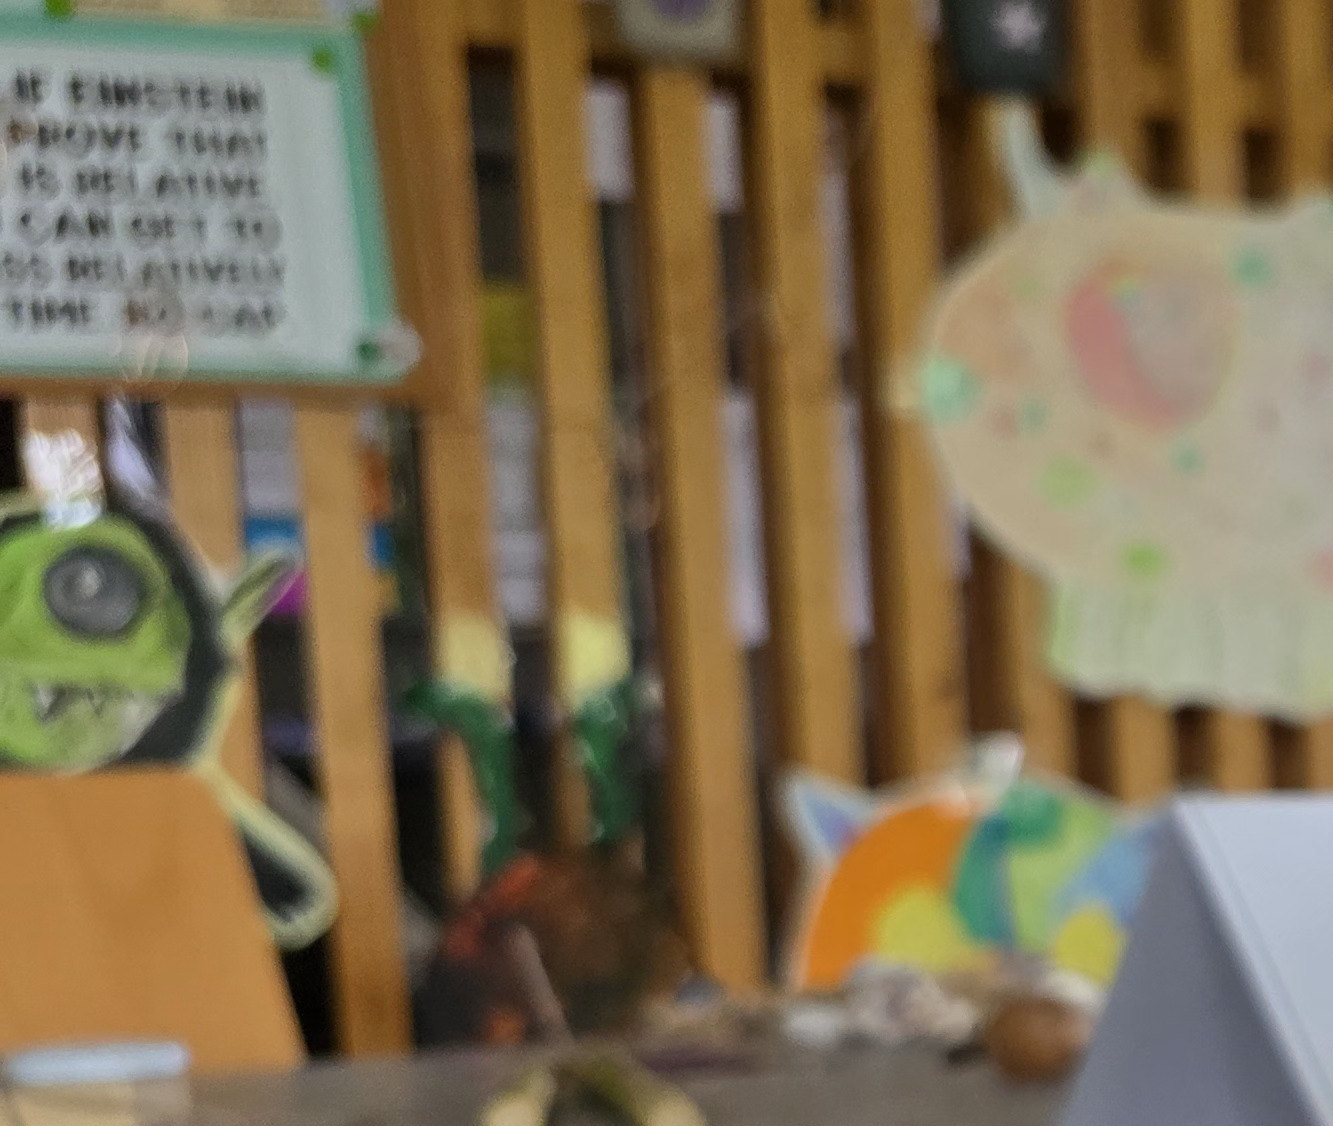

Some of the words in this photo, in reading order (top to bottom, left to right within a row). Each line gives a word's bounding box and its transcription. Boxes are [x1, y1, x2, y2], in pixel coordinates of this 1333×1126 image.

[14, 68, 45, 106] IF
[68, 71, 266, 115] EINSTEIN
[173, 124, 268, 160] THAT
[18, 160, 60, 199] IS
[75, 164, 262, 203] RELATIVE
[18, 207, 113, 247] CAN
[129, 210, 207, 249] GET
[226, 215, 284, 251] TO
[0, 250, 53, 289] SS
[67, 252, 288, 292] RELATIVELY
[8, 297, 90, 330] TIME
